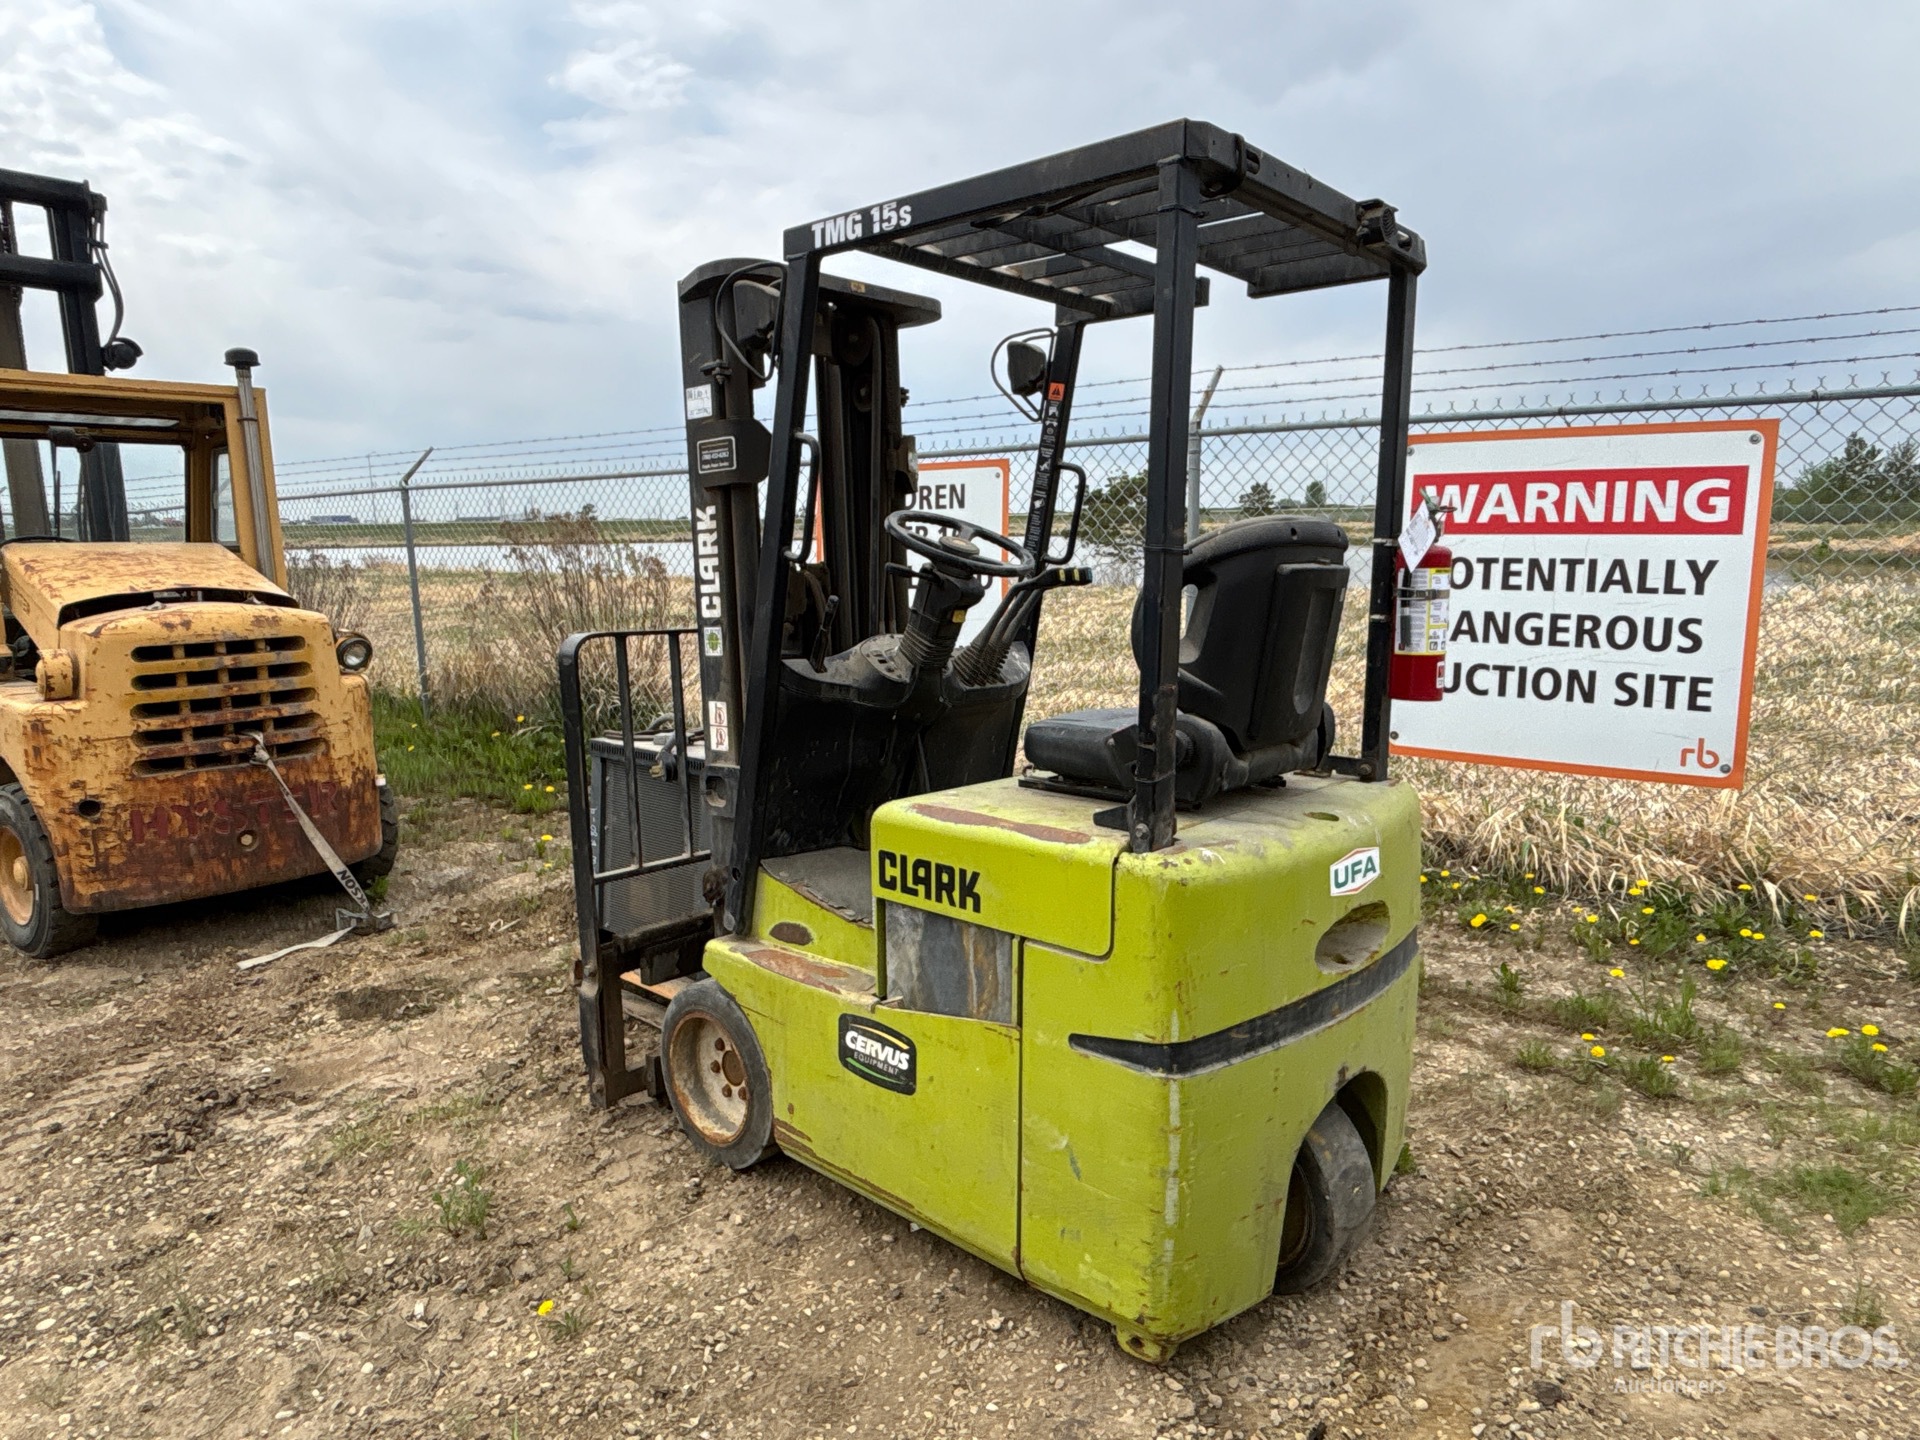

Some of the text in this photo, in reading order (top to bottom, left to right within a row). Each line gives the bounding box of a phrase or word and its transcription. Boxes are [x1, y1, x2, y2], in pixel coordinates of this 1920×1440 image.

[811, 201, 912, 249] TMG 15s
[905, 483, 966, 511] DREN
[1424, 478, 1731, 524] WARNING
[696, 505, 722, 619] CLARK
[1451, 556, 1720, 596] OTENTIALLY
[1449, 610, 1704, 654] ANGEROUS
[1443, 662, 1714, 713] UCTION SITE
[1680, 737, 1720, 769] rb
[337, 870, 369, 908] KSON
[878, 849, 982, 914] CLARK
[1334, 855, 1377, 889] UFA
[845, 1030, 910, 1071] CERVUS
[853, 1051, 899, 1076] EQUIPMENT
